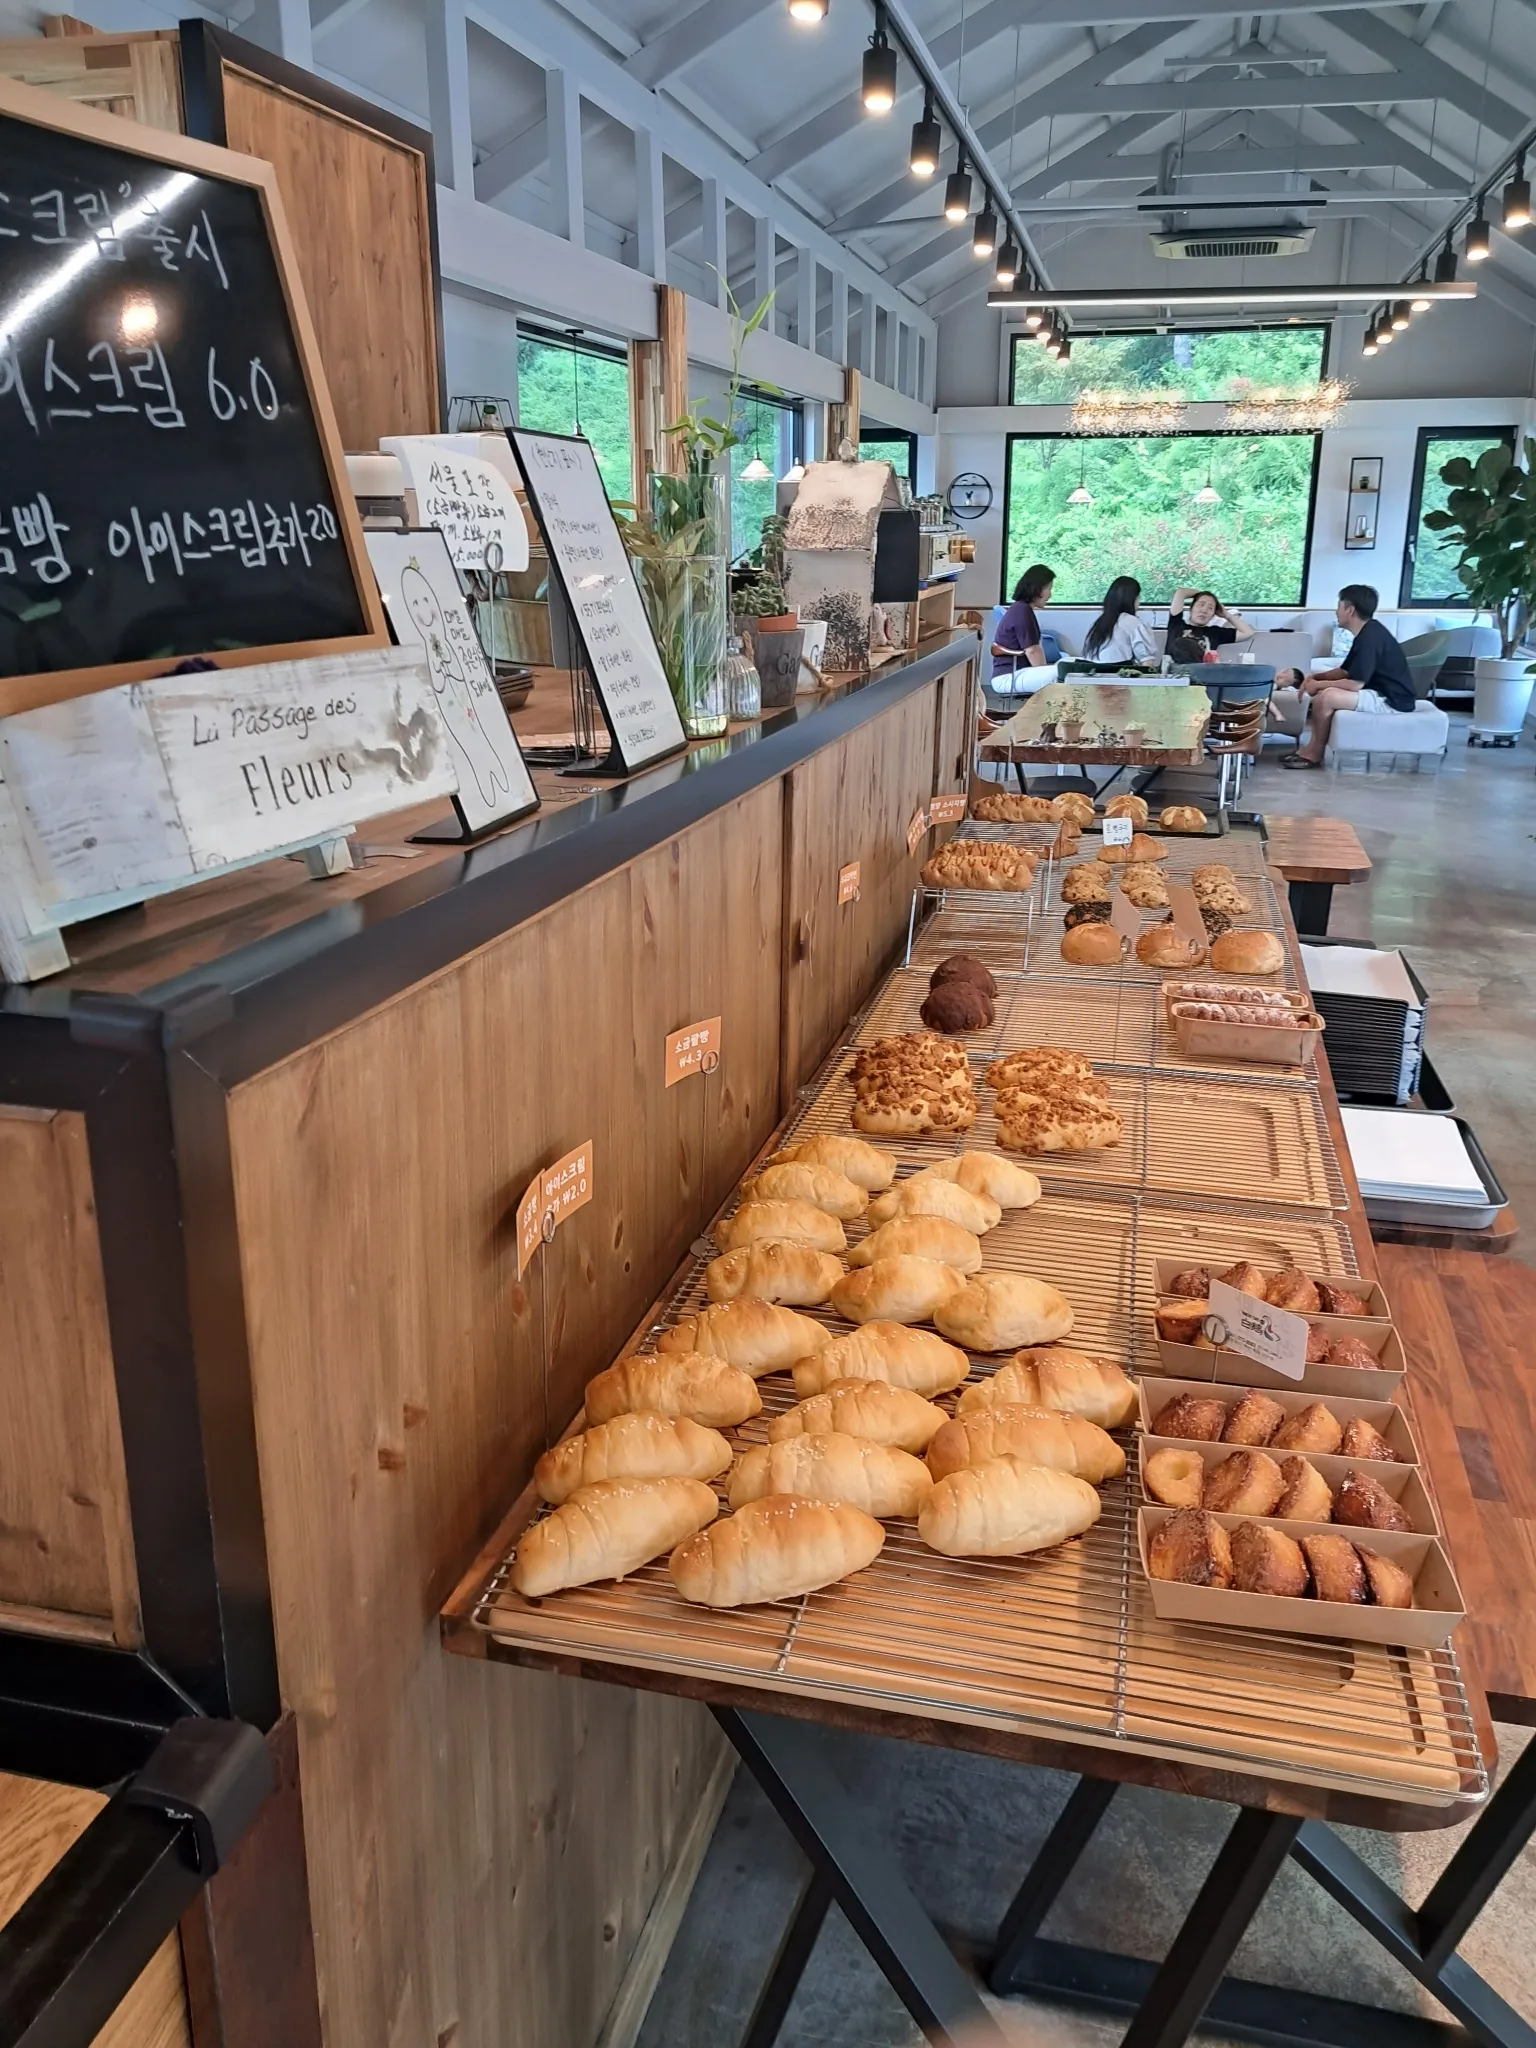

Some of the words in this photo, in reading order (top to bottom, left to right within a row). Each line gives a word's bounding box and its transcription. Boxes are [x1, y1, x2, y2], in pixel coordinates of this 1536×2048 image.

[135, 194, 230, 291] 출시
[207, 346, 280, 422] 6.0
[429, 460, 462, 497] 선물
[231, 706, 317, 740] Passage
[324, 692, 357, 717] des
[239, 751, 353, 816] Fleurs
[545, 1155, 586, 1197] 아이스크림
[562, 1178, 587, 1206] ₩2.0
